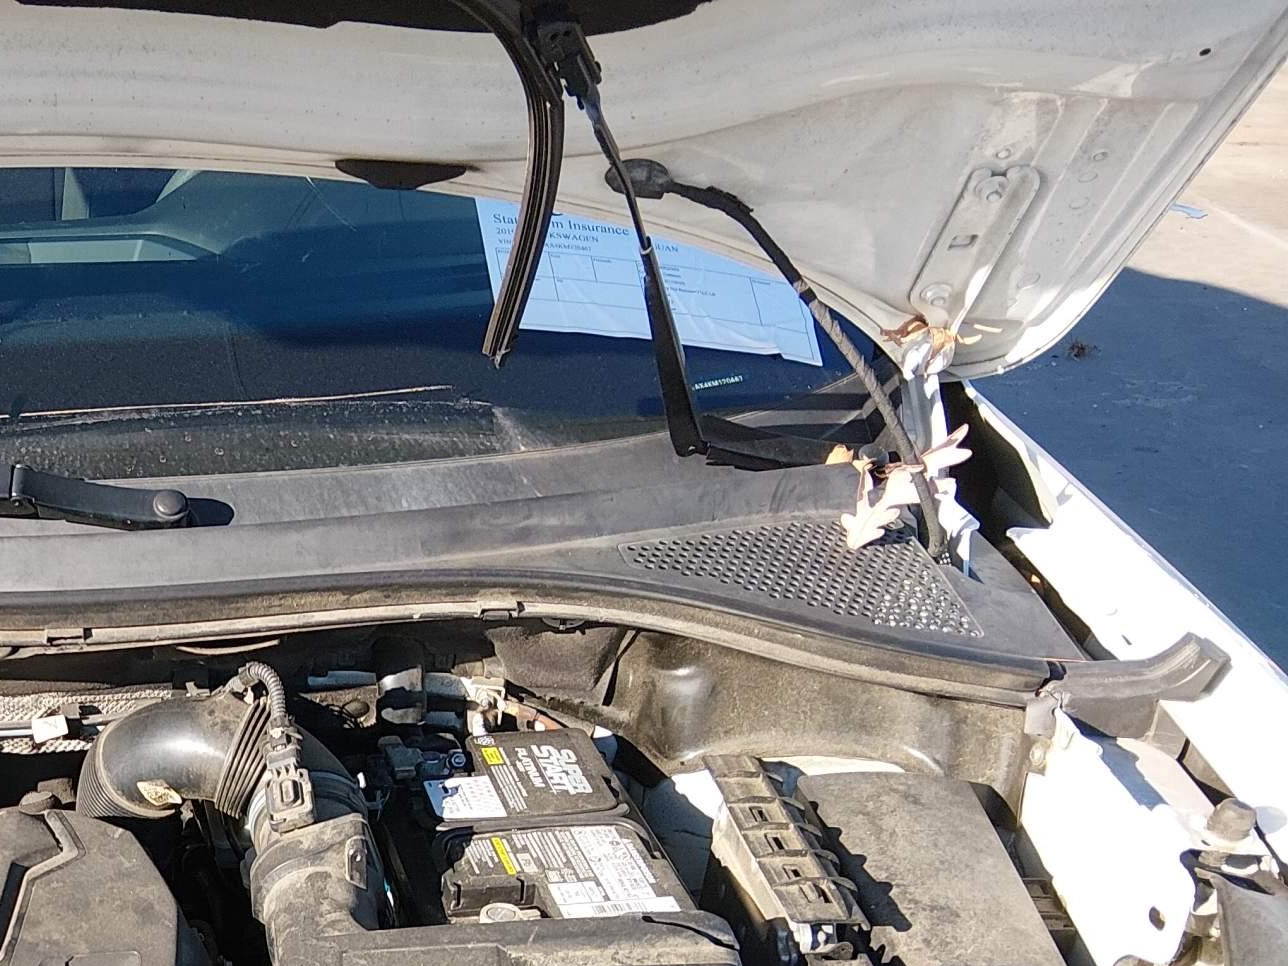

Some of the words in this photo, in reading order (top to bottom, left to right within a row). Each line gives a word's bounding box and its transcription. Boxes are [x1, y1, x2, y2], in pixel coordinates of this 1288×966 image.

[493, 213, 519, 225] Stat
[568, 219, 631, 236] Insurance
[549, 232, 599, 243] KSWAGEN
[515, 747, 545, 788] PLATINUM
[530, 745, 578, 795] START
[560, 749, 593, 794] SUPER
